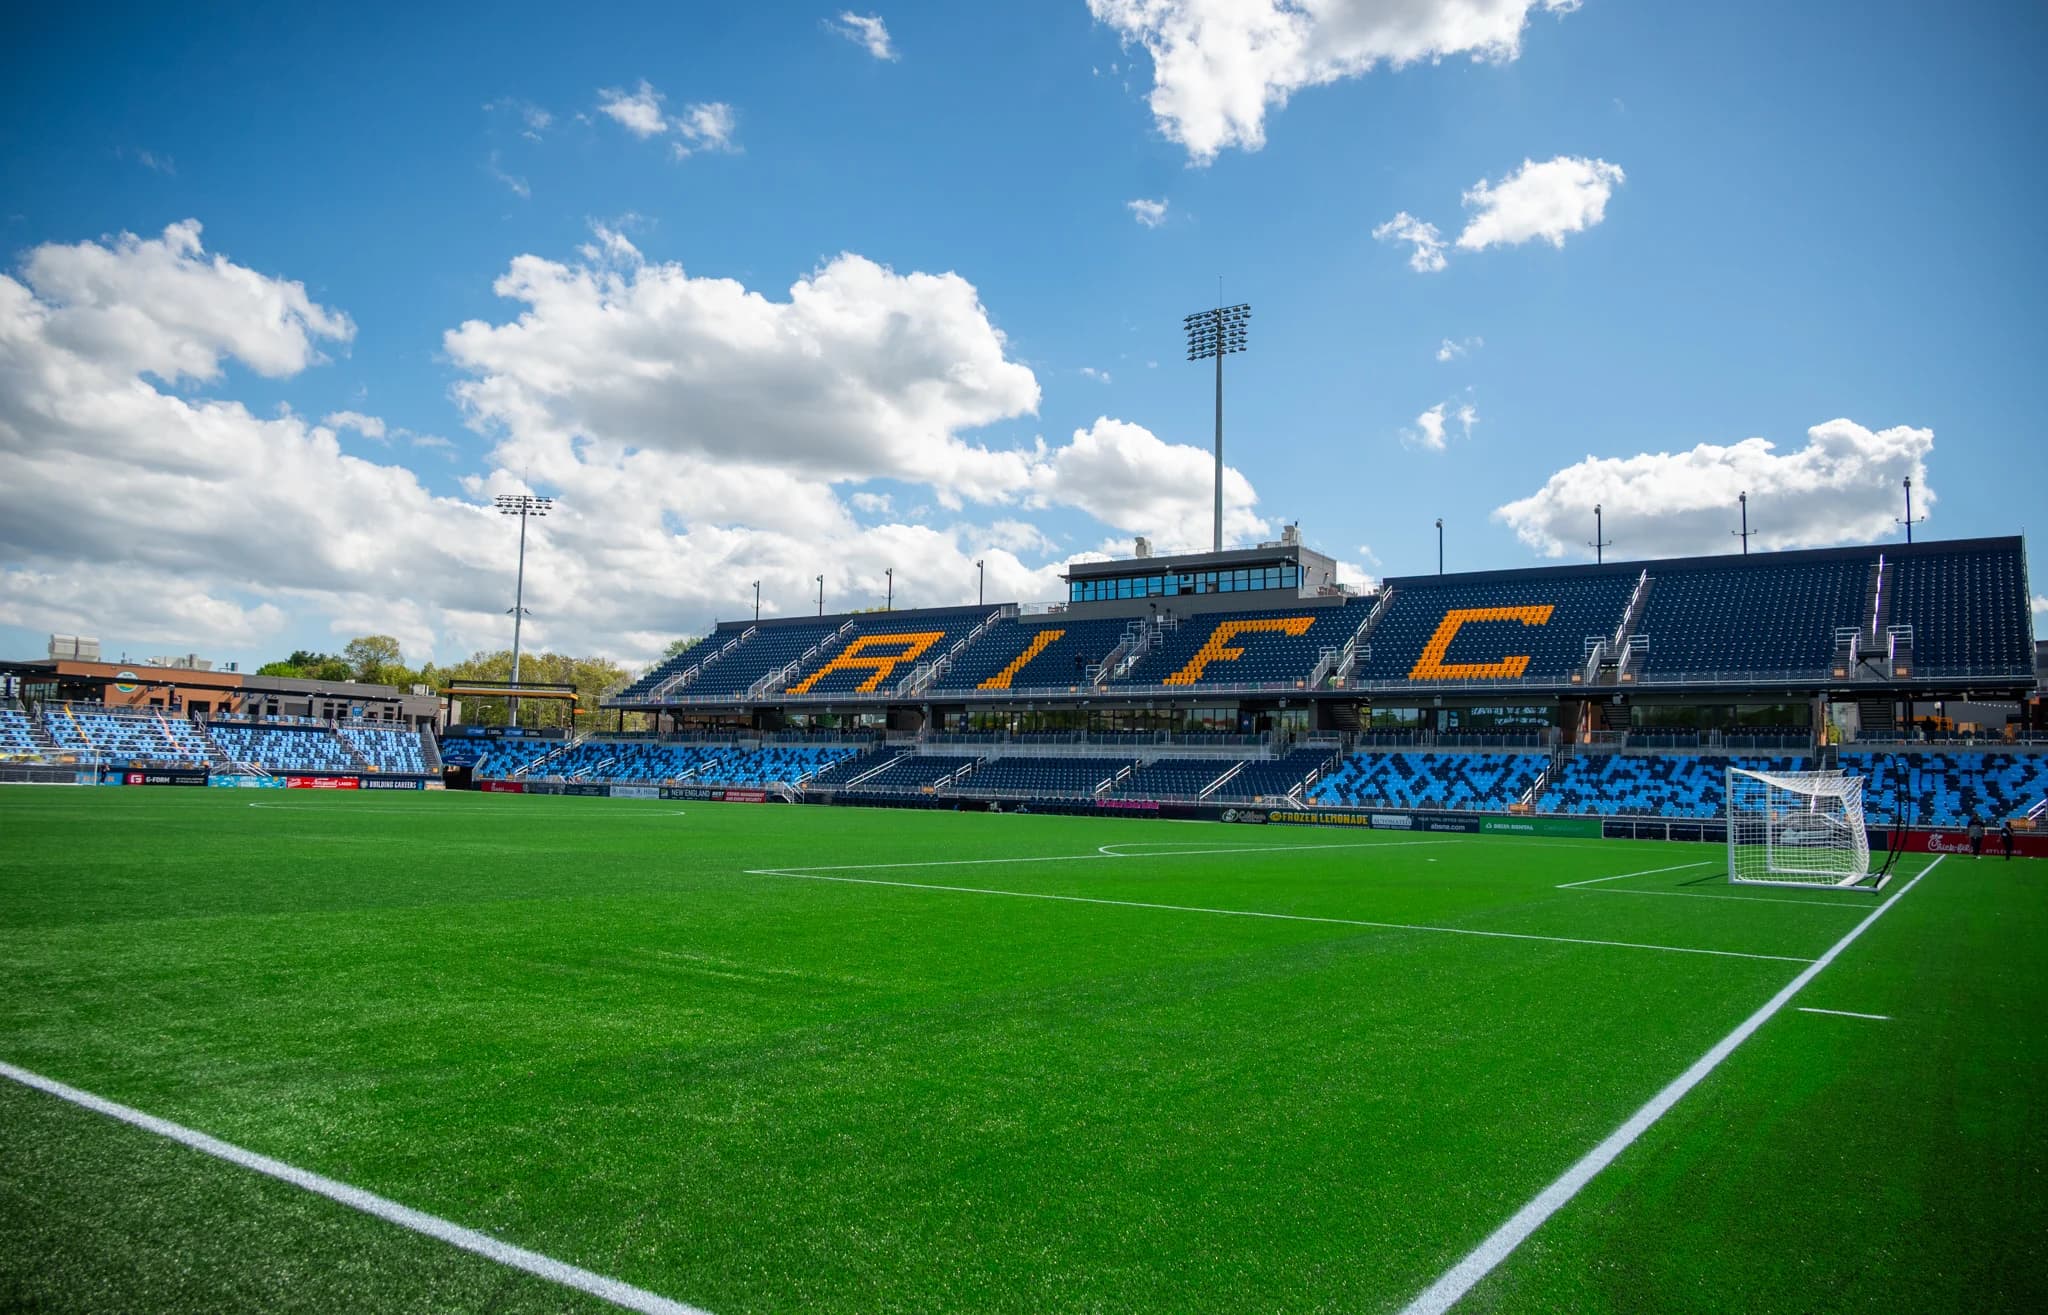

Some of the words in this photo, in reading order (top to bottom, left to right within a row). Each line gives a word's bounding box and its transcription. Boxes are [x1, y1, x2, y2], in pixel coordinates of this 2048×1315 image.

[369, 780, 394, 788] BUILDING
[394, 781, 417, 789] CAREERS
[671, 788, 684, 797] NEW
[685, 789, 711, 798] ENGLAND
[1282, 811, 1318, 823] FROZEN
[1319, 813, 1369, 825] LEMONADE
